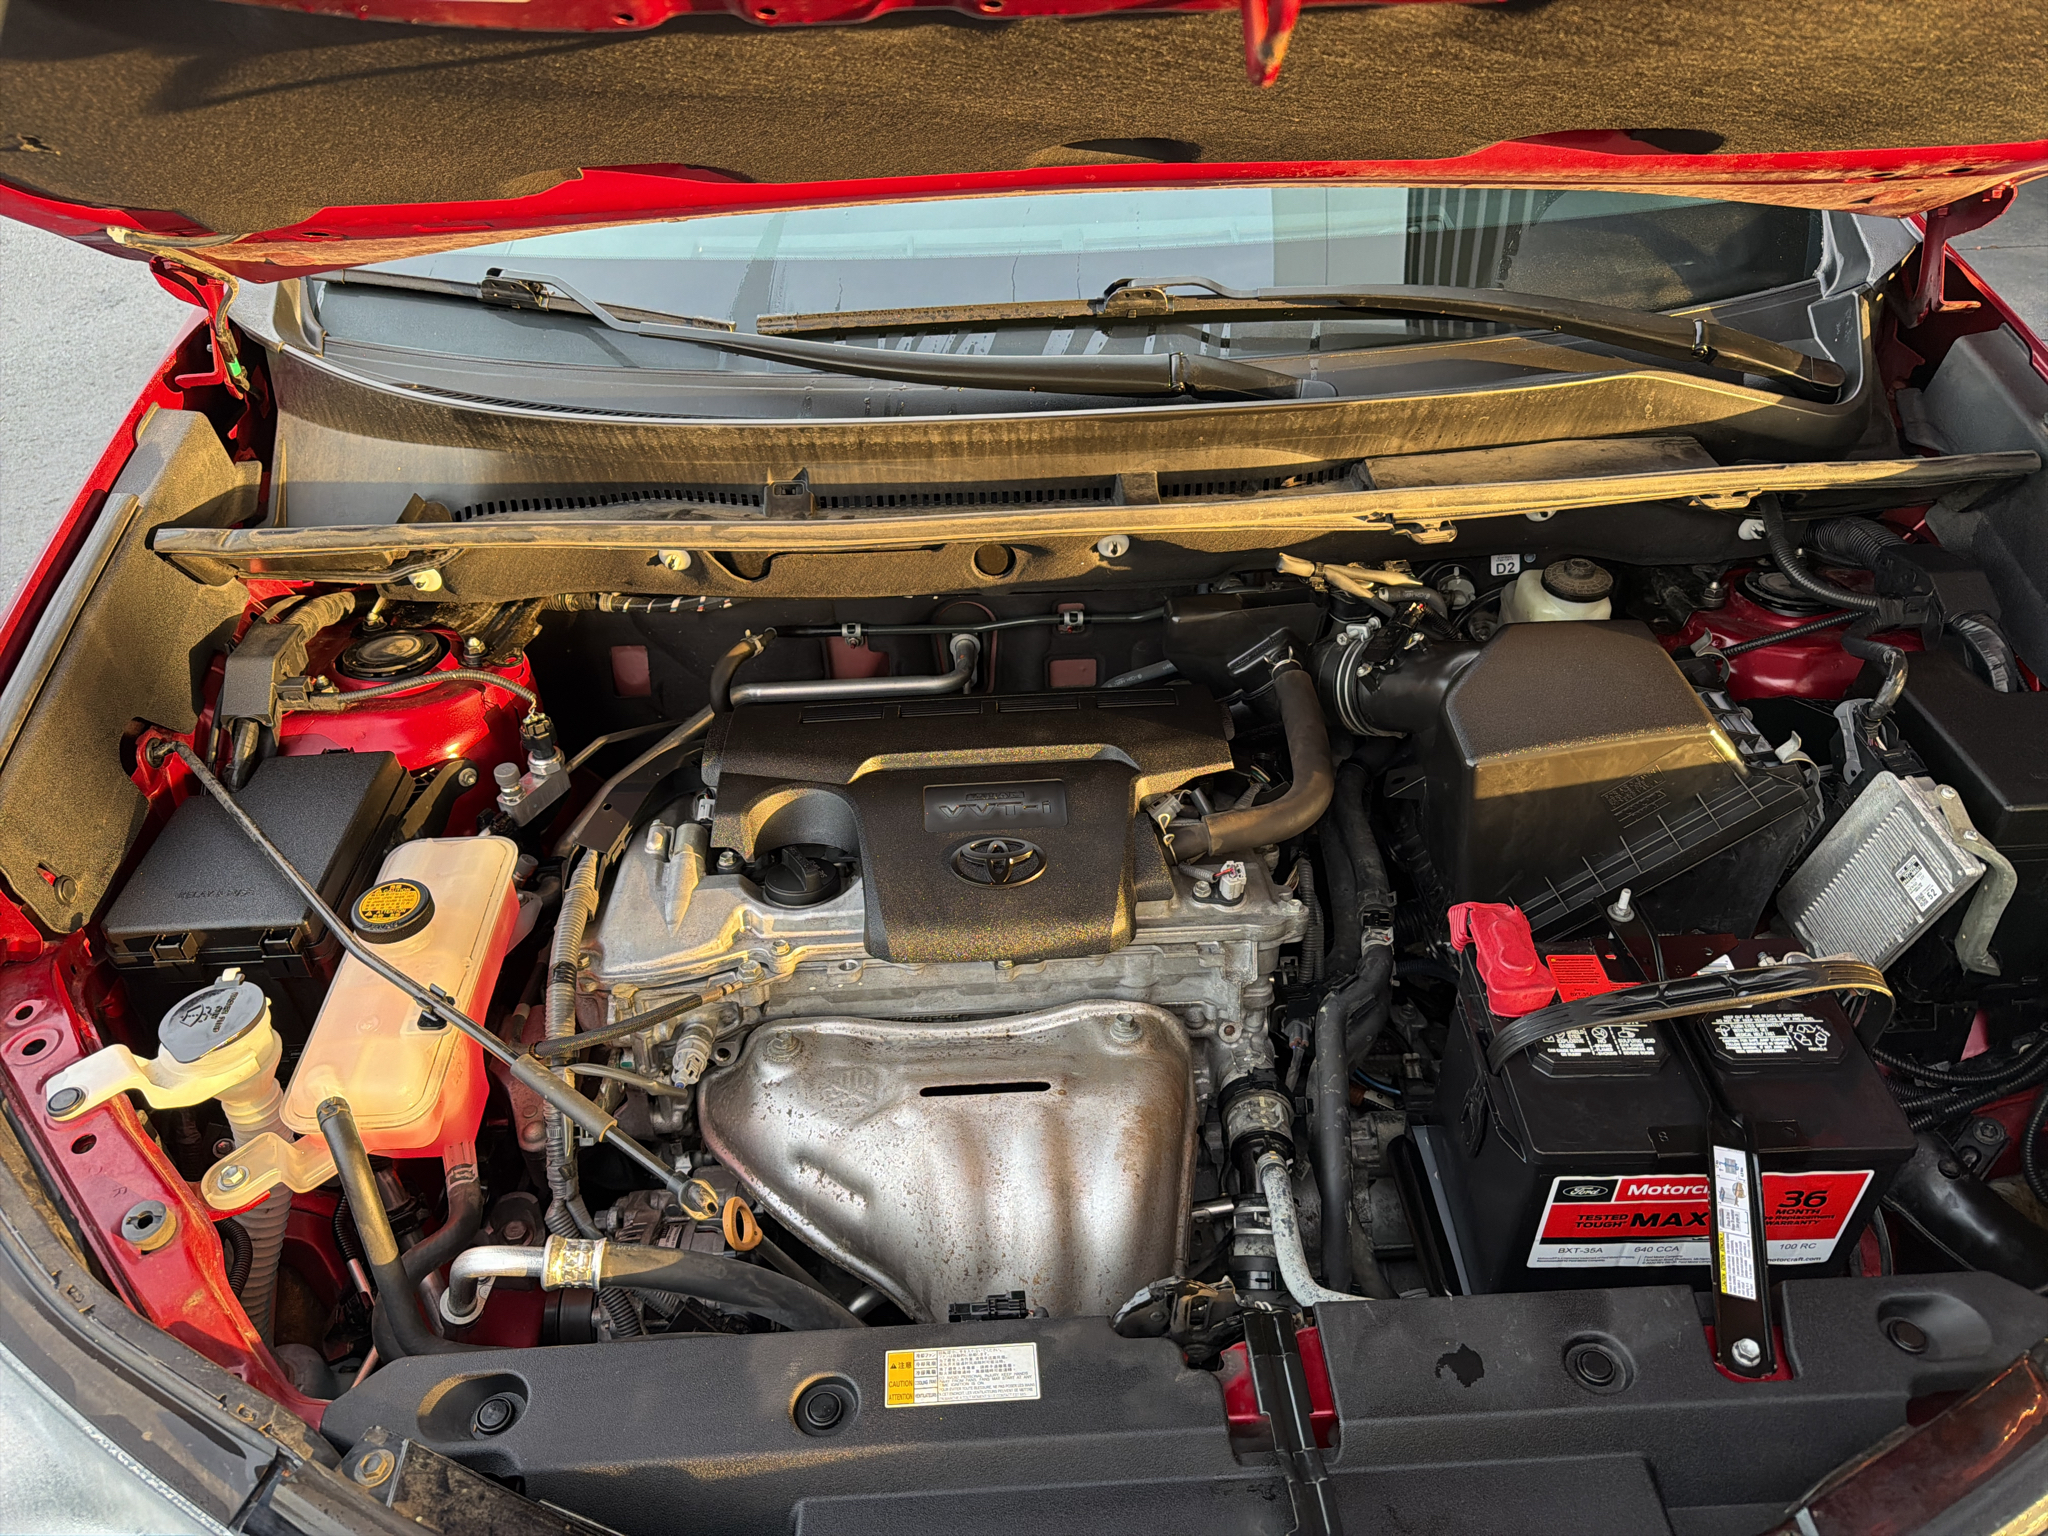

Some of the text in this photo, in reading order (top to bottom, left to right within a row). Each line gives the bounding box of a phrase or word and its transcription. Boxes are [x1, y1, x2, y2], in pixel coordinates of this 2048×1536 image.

[1496, 562, 1515, 574] D2
[939, 800, 1051, 818] VVT-i
[1570, 1187, 1600, 1195] Ford
[1628, 1184, 1708, 1195] Motorc
[1778, 1190, 1828, 1208] 36
[1630, 1212, 1709, 1227] MAX
[898, 1361, 912, 1369] 注意
[889, 1380, 912, 1388] CAUTION
